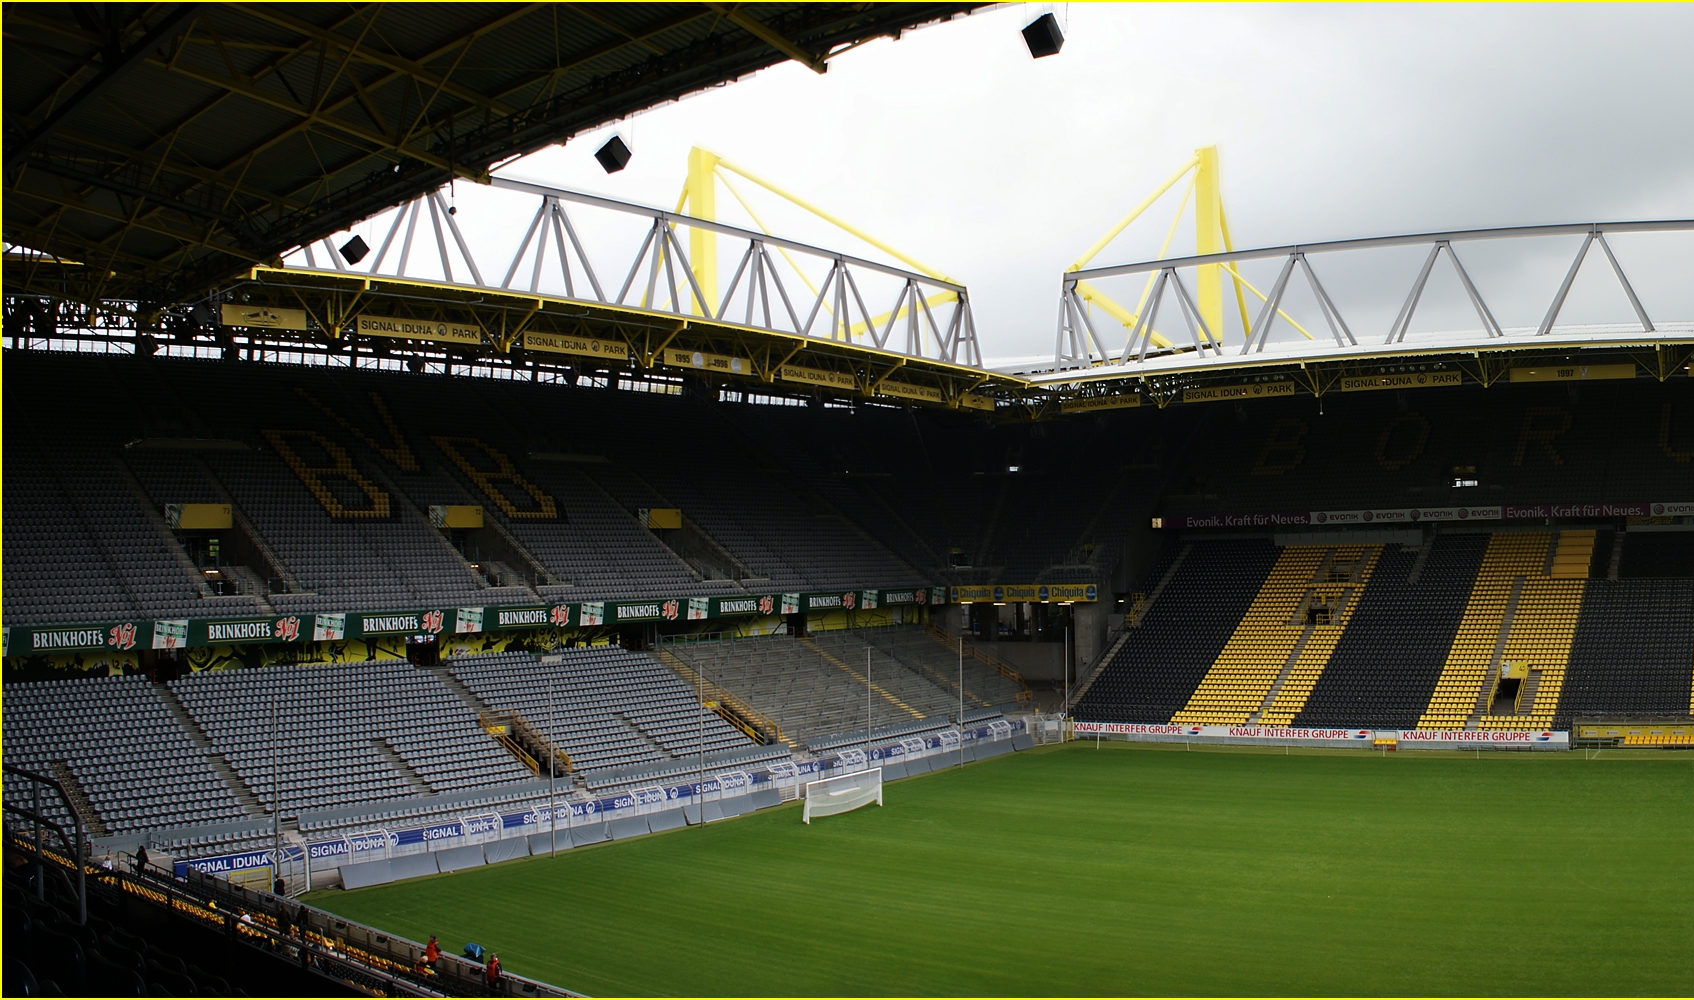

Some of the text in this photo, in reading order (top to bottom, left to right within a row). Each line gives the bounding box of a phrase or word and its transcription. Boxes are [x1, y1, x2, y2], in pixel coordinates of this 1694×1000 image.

[361, 320, 477, 339] SIGNAL IDUNA PARK
[527, 336, 626, 355] SIGNAL IDUNA PARK
[675, 353, 690, 364] 1995
[784, 368, 853, 386] SIGNAL IDUNA PARK
[1557, 369, 1574, 378] 1997
[1344, 374, 1459, 389] SIGNAL IDUNA PARK
[882, 383, 940, 399] SIGNAL IDUNA PARK
[1185, 384, 1292, 401] SIGNAL IDUNA PARK
[1063, 396, 1138, 410] SIGNAL IDUNA PARK
[223, 508, 230, 517] 73
[475, 508, 482, 516] 72
[1506, 504, 1644, 518] Evonik. Kraft für Neues.
[1186, 514, 1308, 528] Evonik. Kraft für Neues.
[959, 586, 991, 600] Chiquita
[1051, 587, 1084, 600] Chiquita
[1073, 722, 1183, 735] KNAUF INTERFER GRUPPE
[1229, 727, 1349, 739] KNAUF INTERFER GRUPPE
[1402, 731, 1530, 742] KNAUF INTERFER GRUPPE
[695, 776, 744, 794] SGNAL DUNA
[614, 794, 643, 809] SIGNL
[557, 805, 583, 819] IDNA
[422, 821, 493, 841] SIGNAL IUNA
[311, 843, 349, 858] SIGNAL
[233, 854, 269, 869] IDUNA
